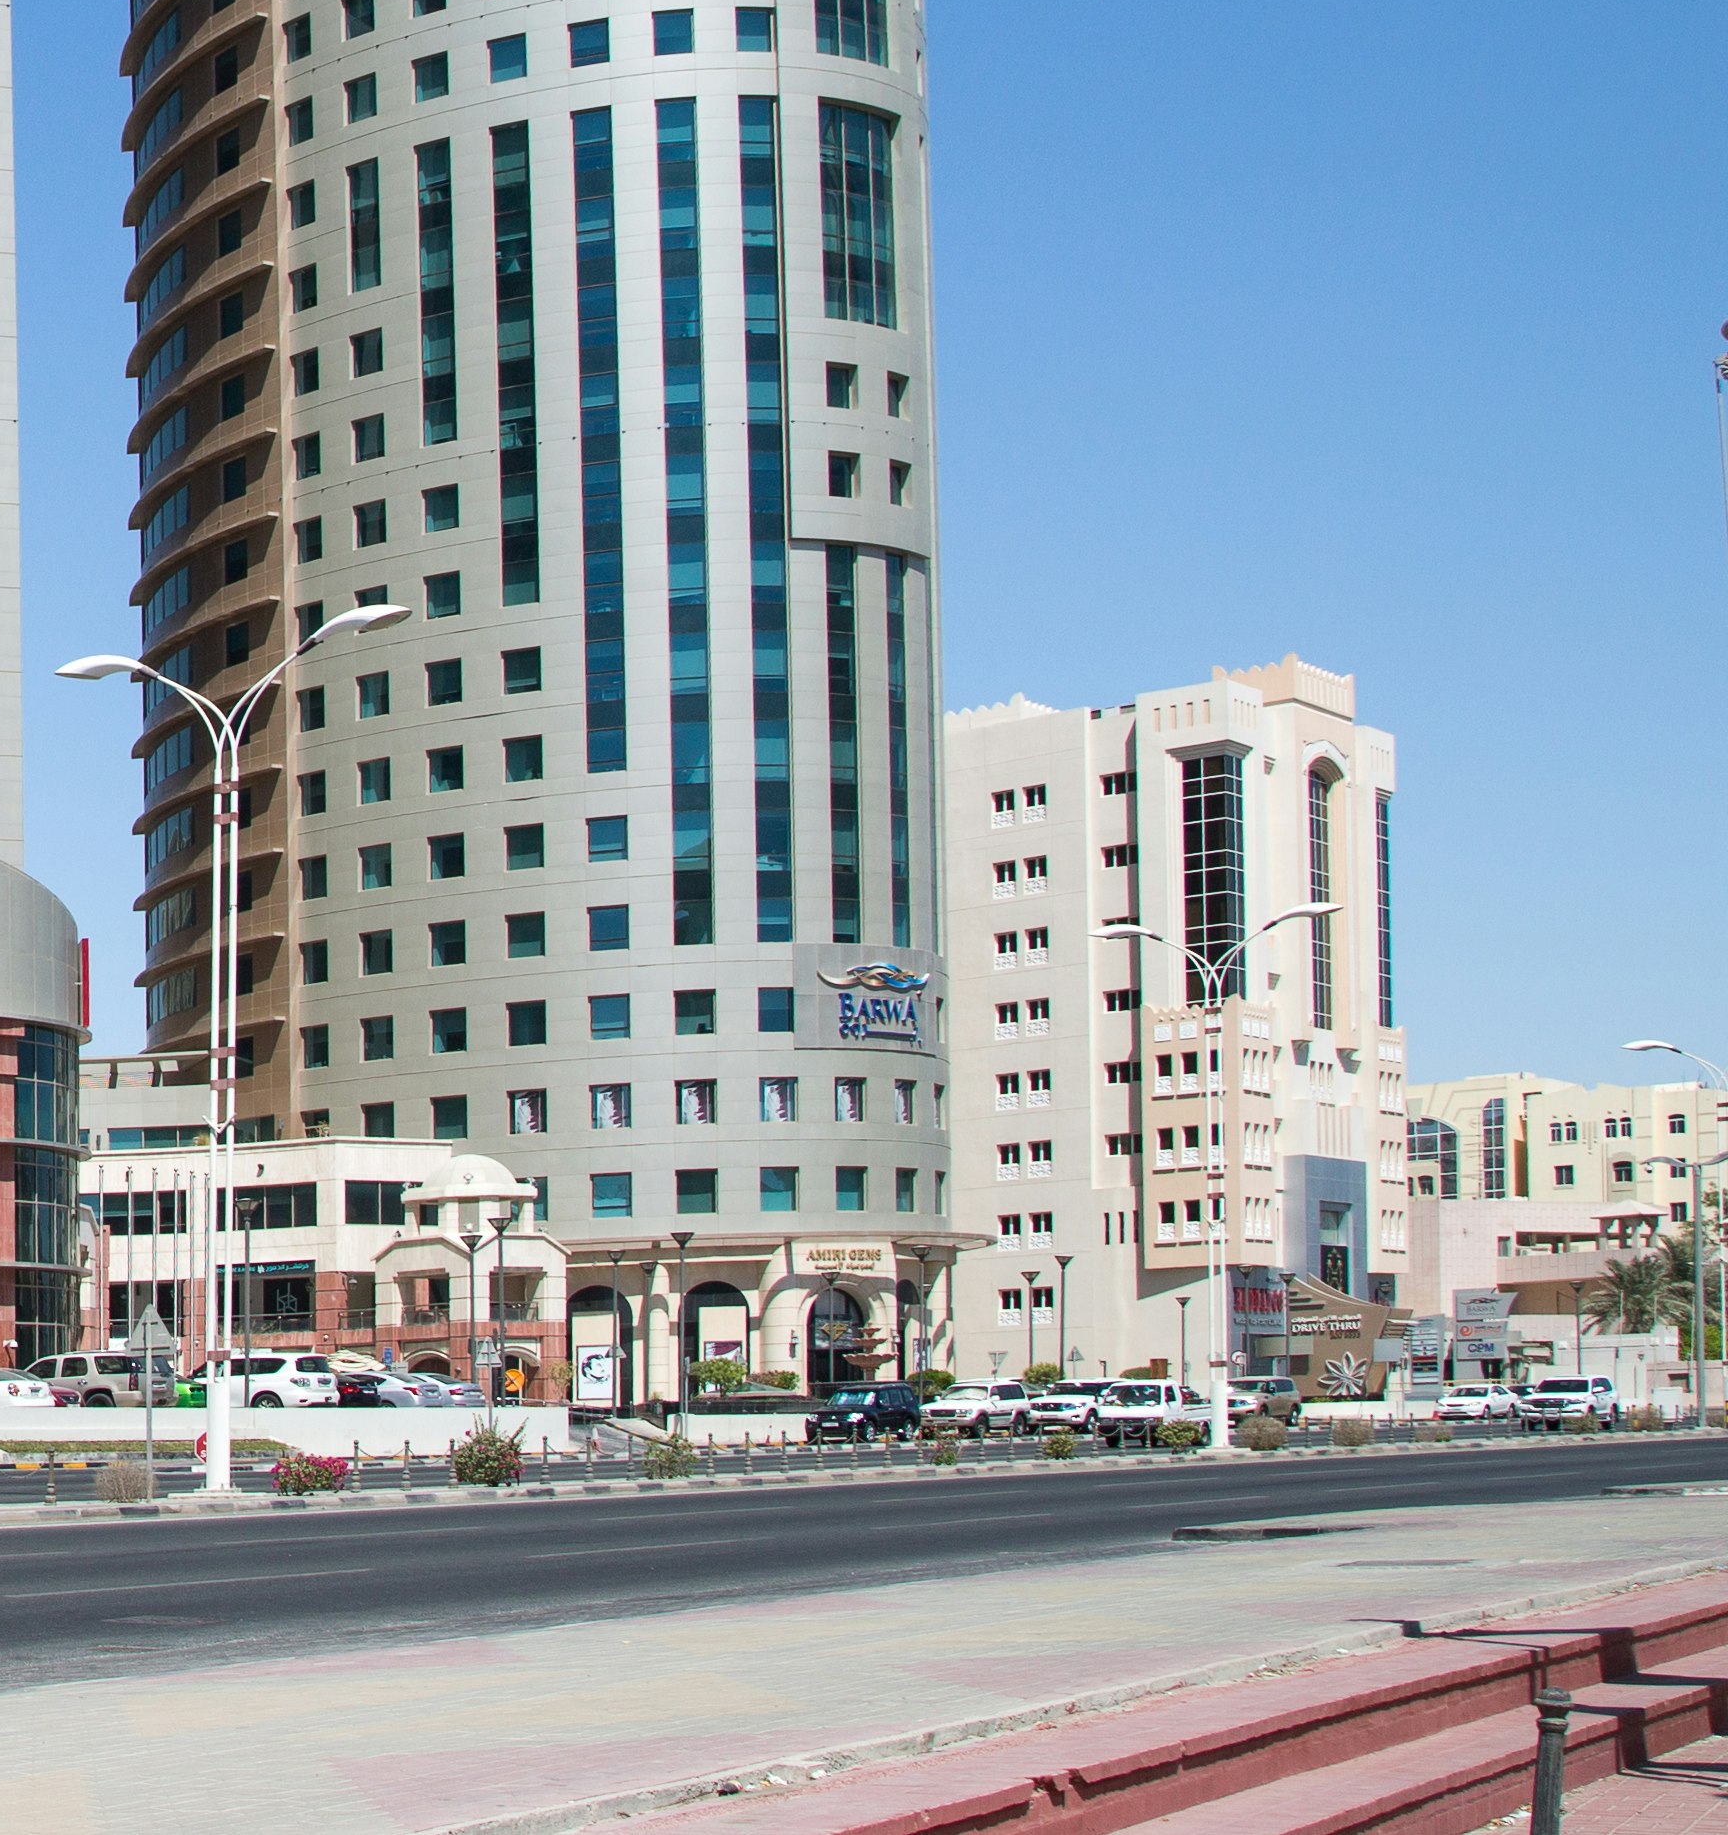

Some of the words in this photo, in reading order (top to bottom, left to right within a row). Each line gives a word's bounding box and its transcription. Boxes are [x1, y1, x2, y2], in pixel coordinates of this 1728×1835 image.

[838, 992, 918, 1026] BARWA
[806, 1248, 846, 1261] AMIRI
[848, 1248, 882, 1261] GEMS
[1291, 1322, 1326, 1333] DRIVE
[1328, 1320, 1361, 1331] THRU
